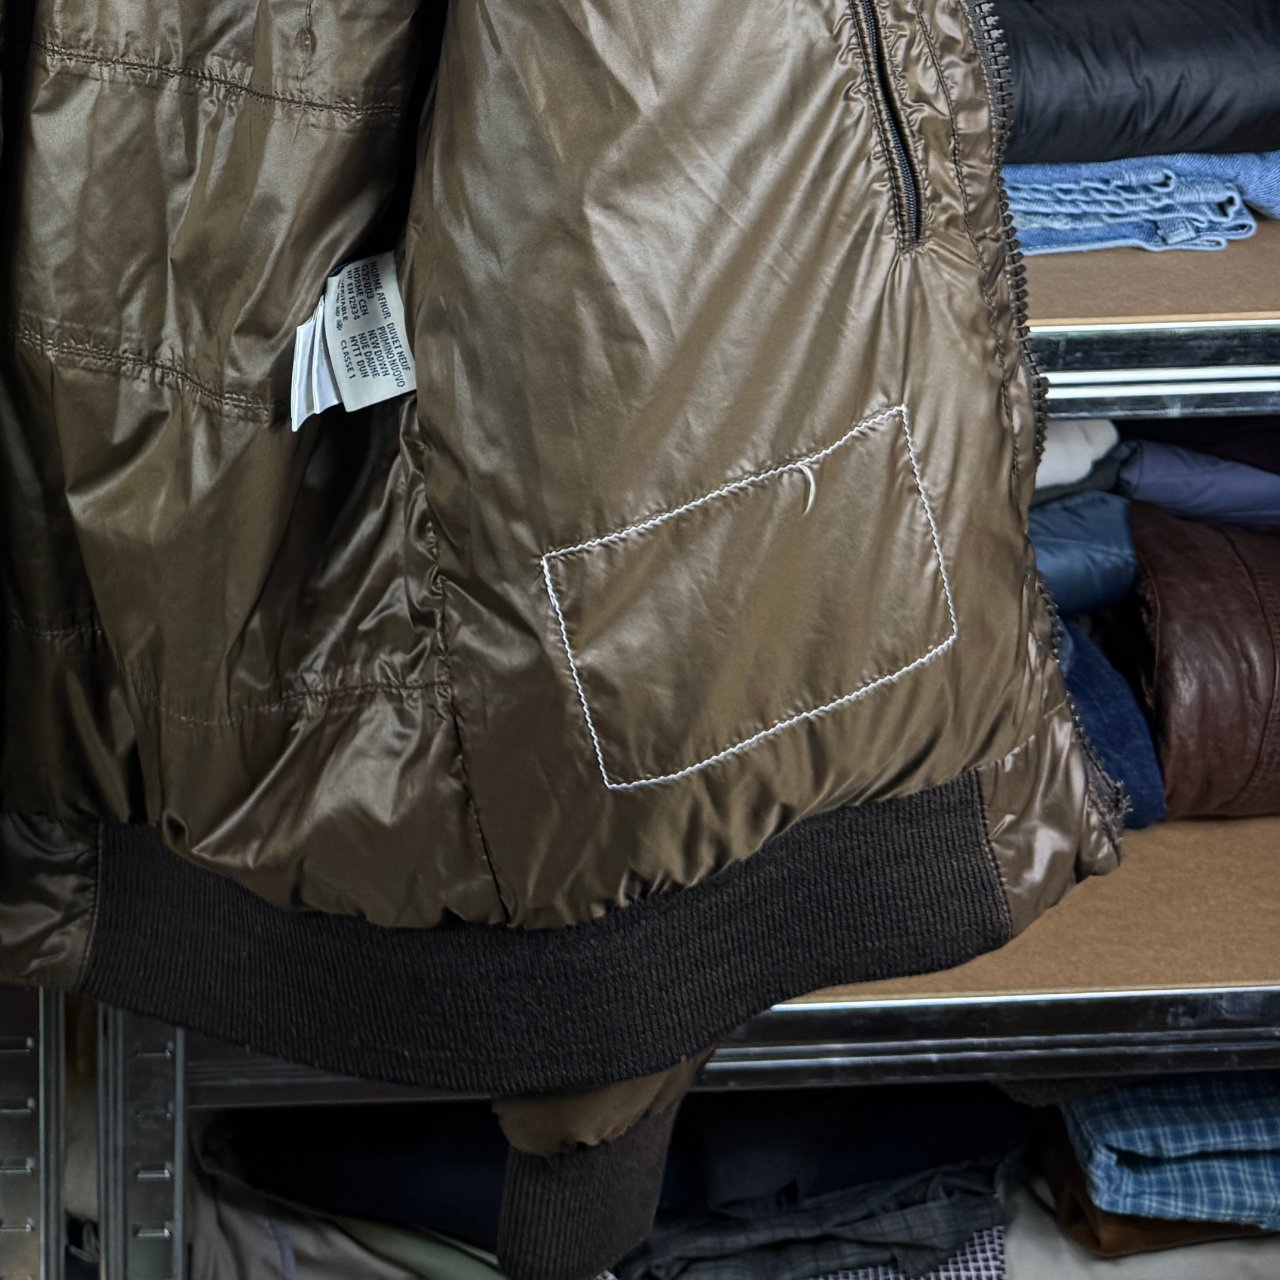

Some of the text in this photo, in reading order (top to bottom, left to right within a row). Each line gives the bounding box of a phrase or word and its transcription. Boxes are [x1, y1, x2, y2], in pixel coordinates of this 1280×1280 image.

[349, 295, 360, 320] 12934
[358, 300, 370, 316] CEN
[376, 292, 392, 319] AFNOR
[340, 340, 354, 373] CLASSE
[349, 336, 370, 378] NYTT DUN
[368, 329, 390, 376] NEW DOWN
[376, 325, 406, 388] PIUMINO NUOVO
[386, 322, 410, 371] DUVET NEUF
[364, 350, 380, 379] DAUNE
